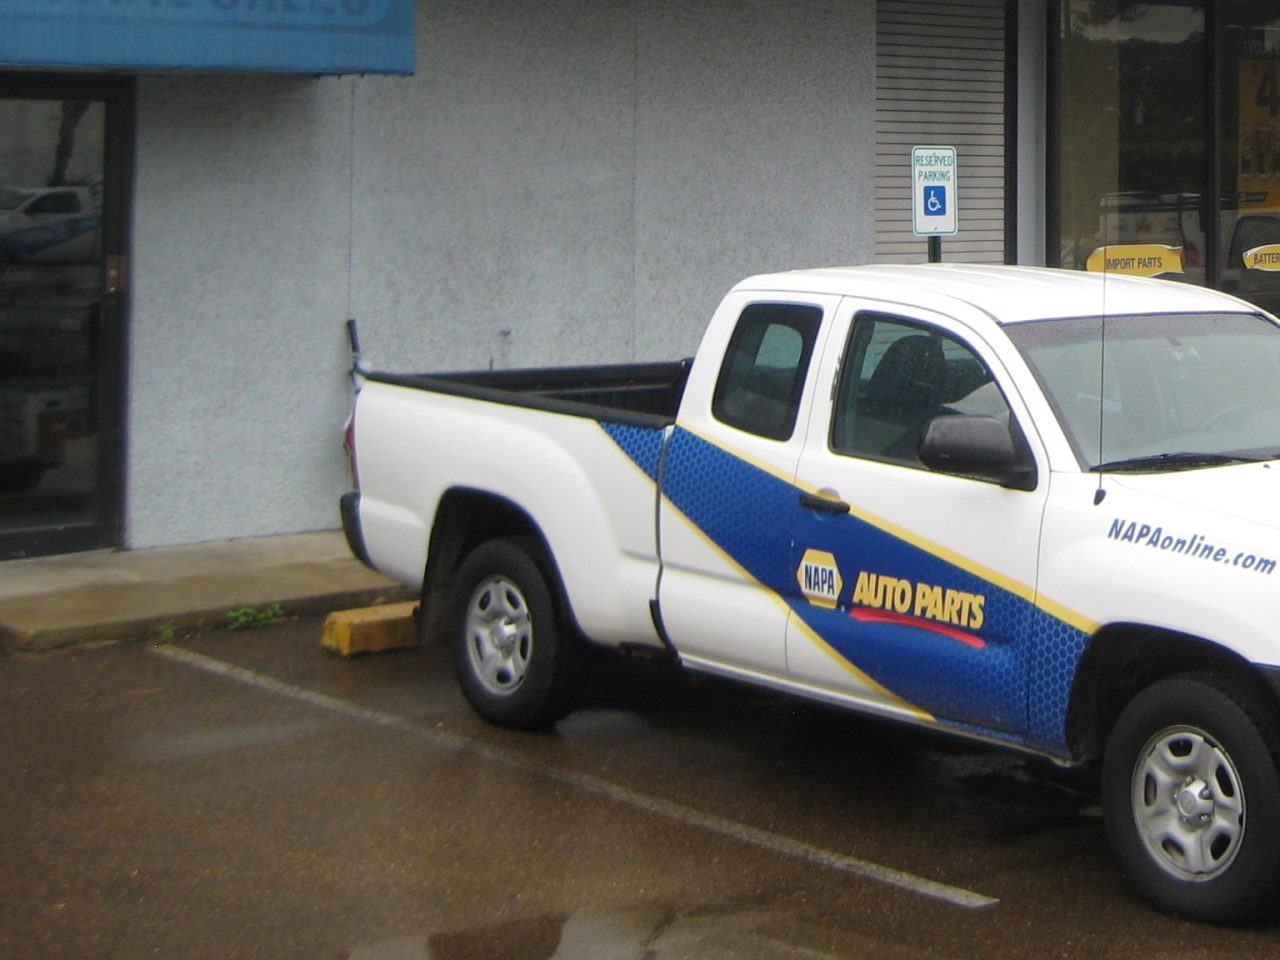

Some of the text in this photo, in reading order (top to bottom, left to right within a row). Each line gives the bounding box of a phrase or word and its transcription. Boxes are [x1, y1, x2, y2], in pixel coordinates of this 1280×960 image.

[915, 155, 953, 167] RESERVED
[918, 170, 951, 182] PARKING
[1106, 257, 1162, 270] IMPORT PARTS
[1107, 518, 1277, 575] NAPAonline.com
[804, 563, 835, 596] NAPA
[852, 571, 986, 629] AUTO PARTS
